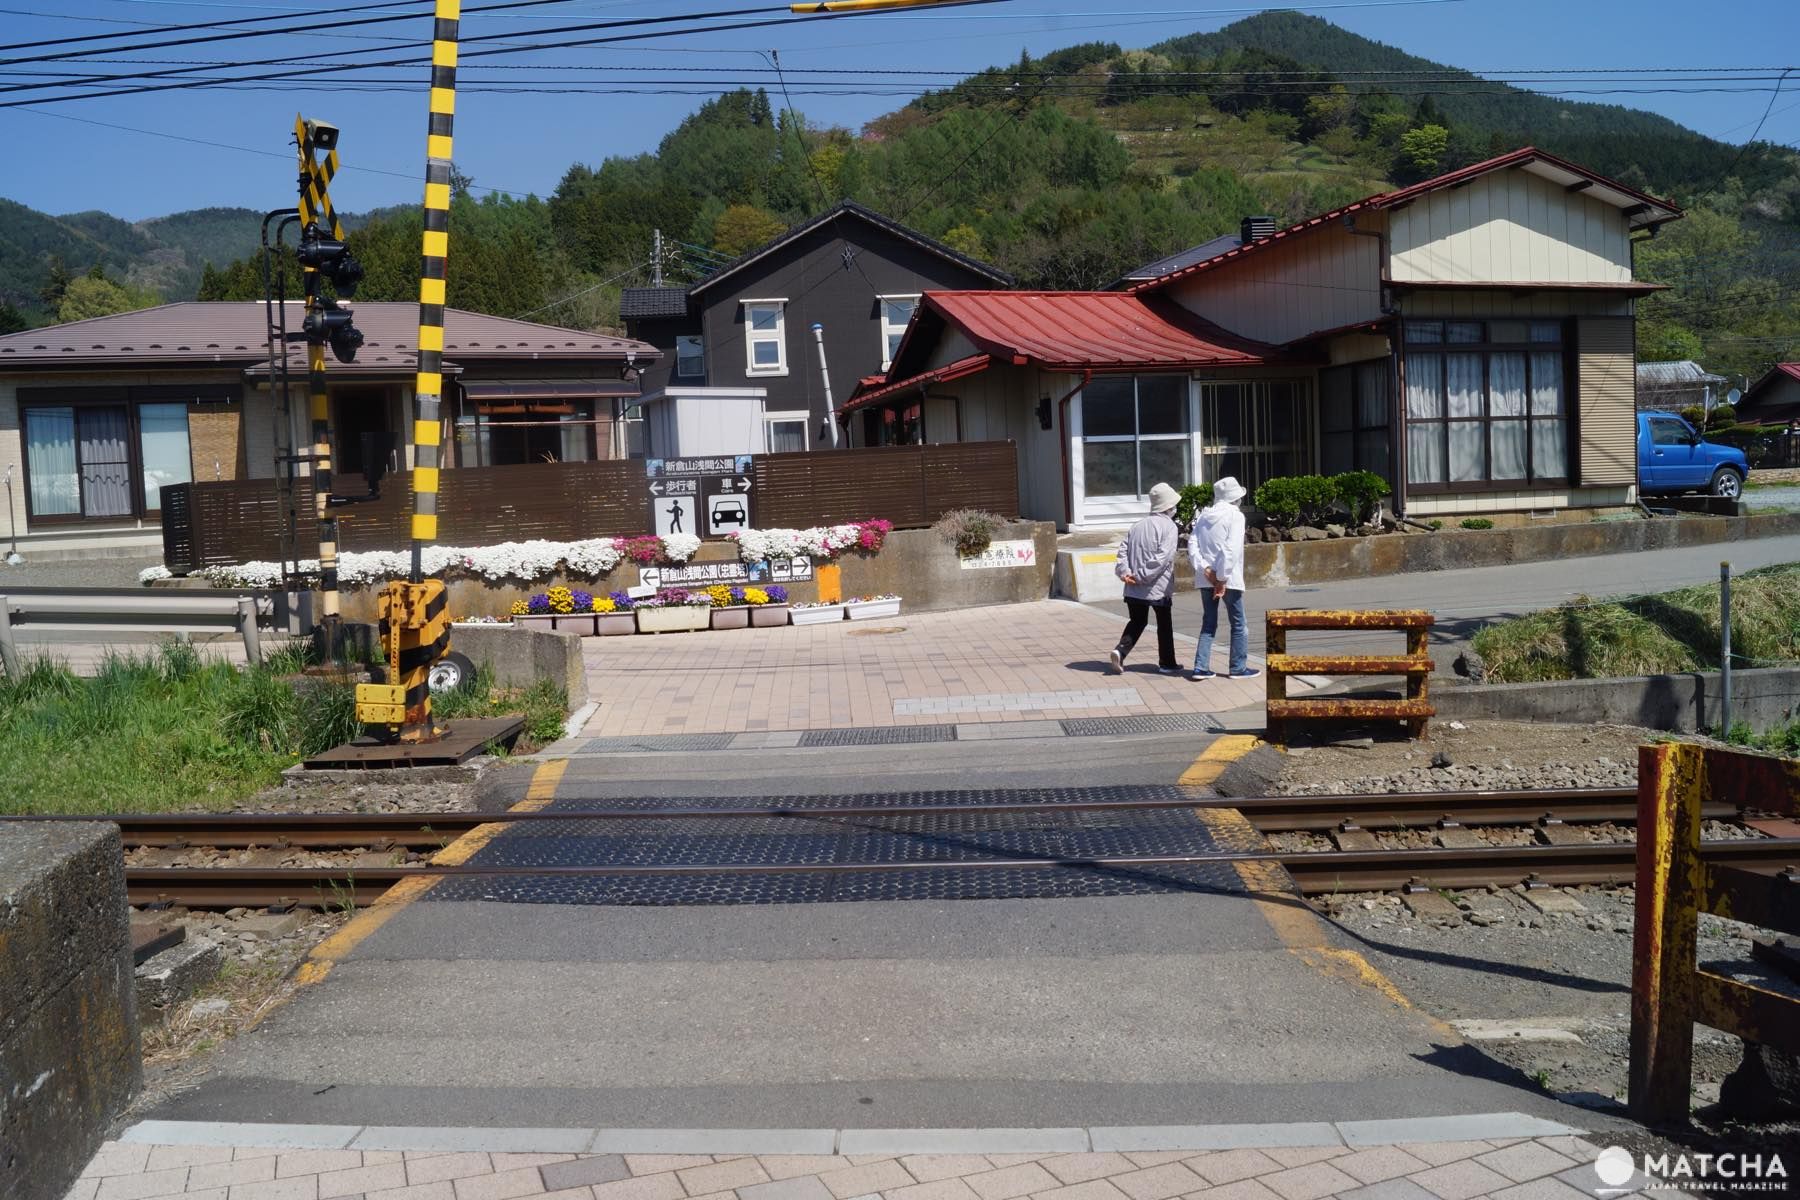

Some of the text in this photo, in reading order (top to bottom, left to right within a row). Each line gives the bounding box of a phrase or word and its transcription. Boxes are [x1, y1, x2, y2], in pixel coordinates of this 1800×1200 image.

[665, 459, 734, 472] 新倉山浅間公園
[665, 480, 697, 492] 歩行者
[721, 478, 733, 489] 車
